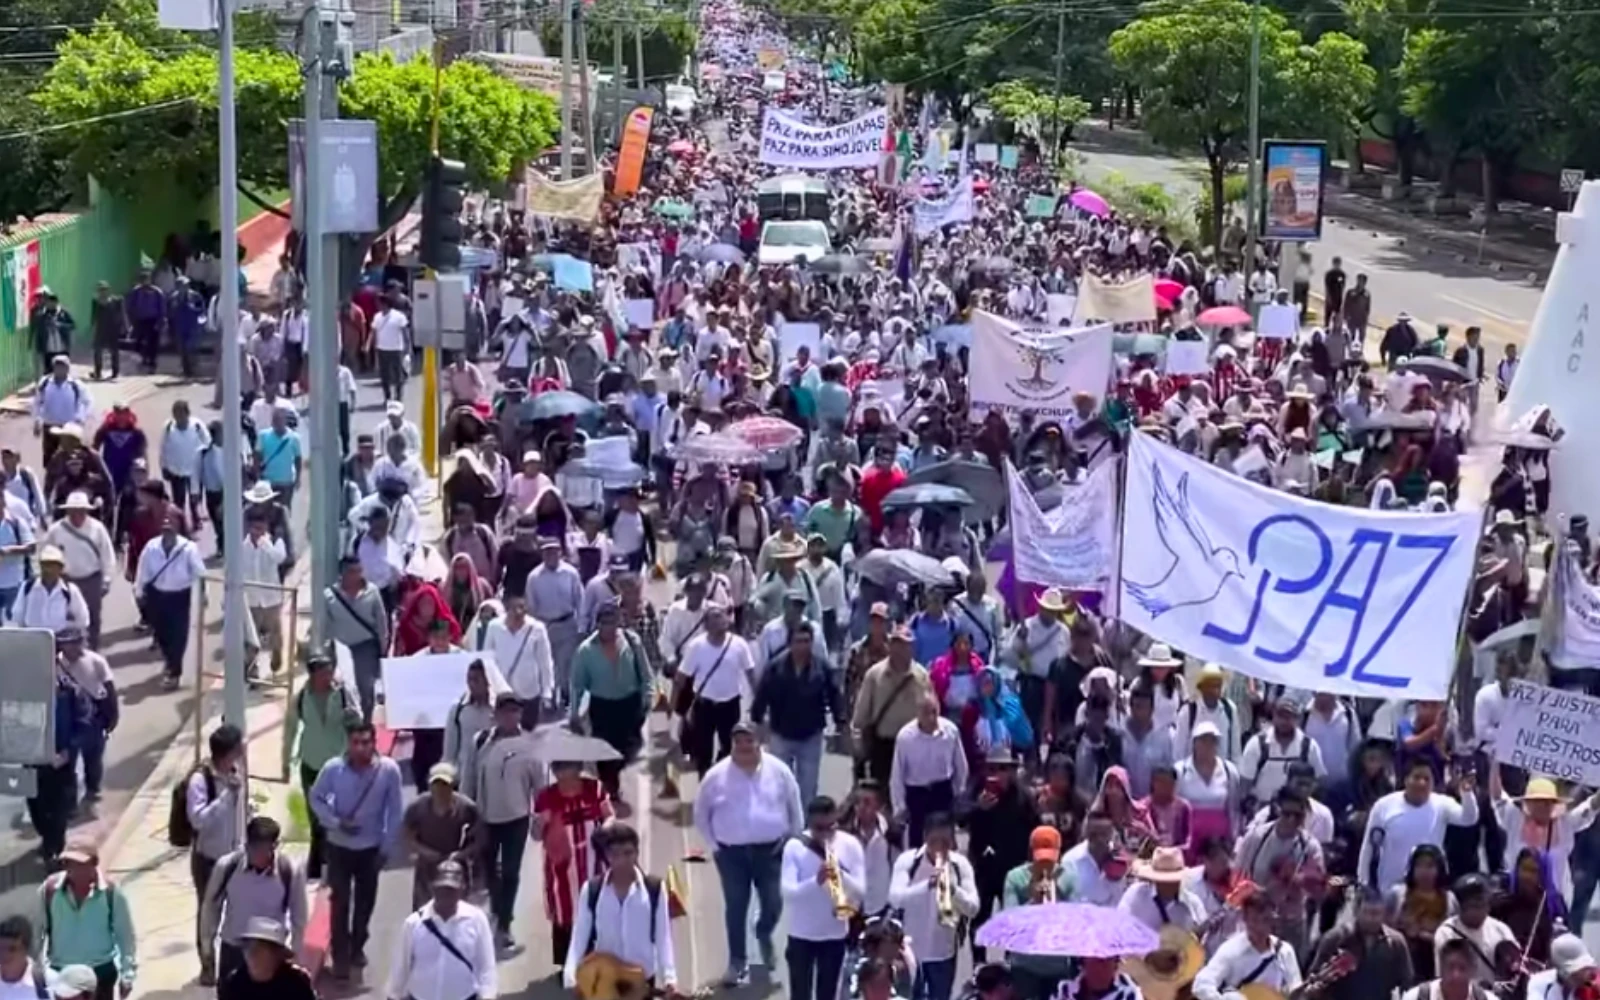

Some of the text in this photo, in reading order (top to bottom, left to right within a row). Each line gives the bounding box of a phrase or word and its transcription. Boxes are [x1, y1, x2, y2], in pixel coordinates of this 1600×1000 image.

[766, 115, 885, 142] PAZ PARA CHIAPAS
[764, 138, 787, 154] PAZ
[788, 142, 819, 157] PARA
[1201, 513, 1458, 688] PAZ
[1538, 689, 1550, 706] Y
[1537, 711, 1580, 735] PARA
[1516, 728, 1600, 765] NUESTROS
[1511, 749, 1583, 781] PUEBLOS
